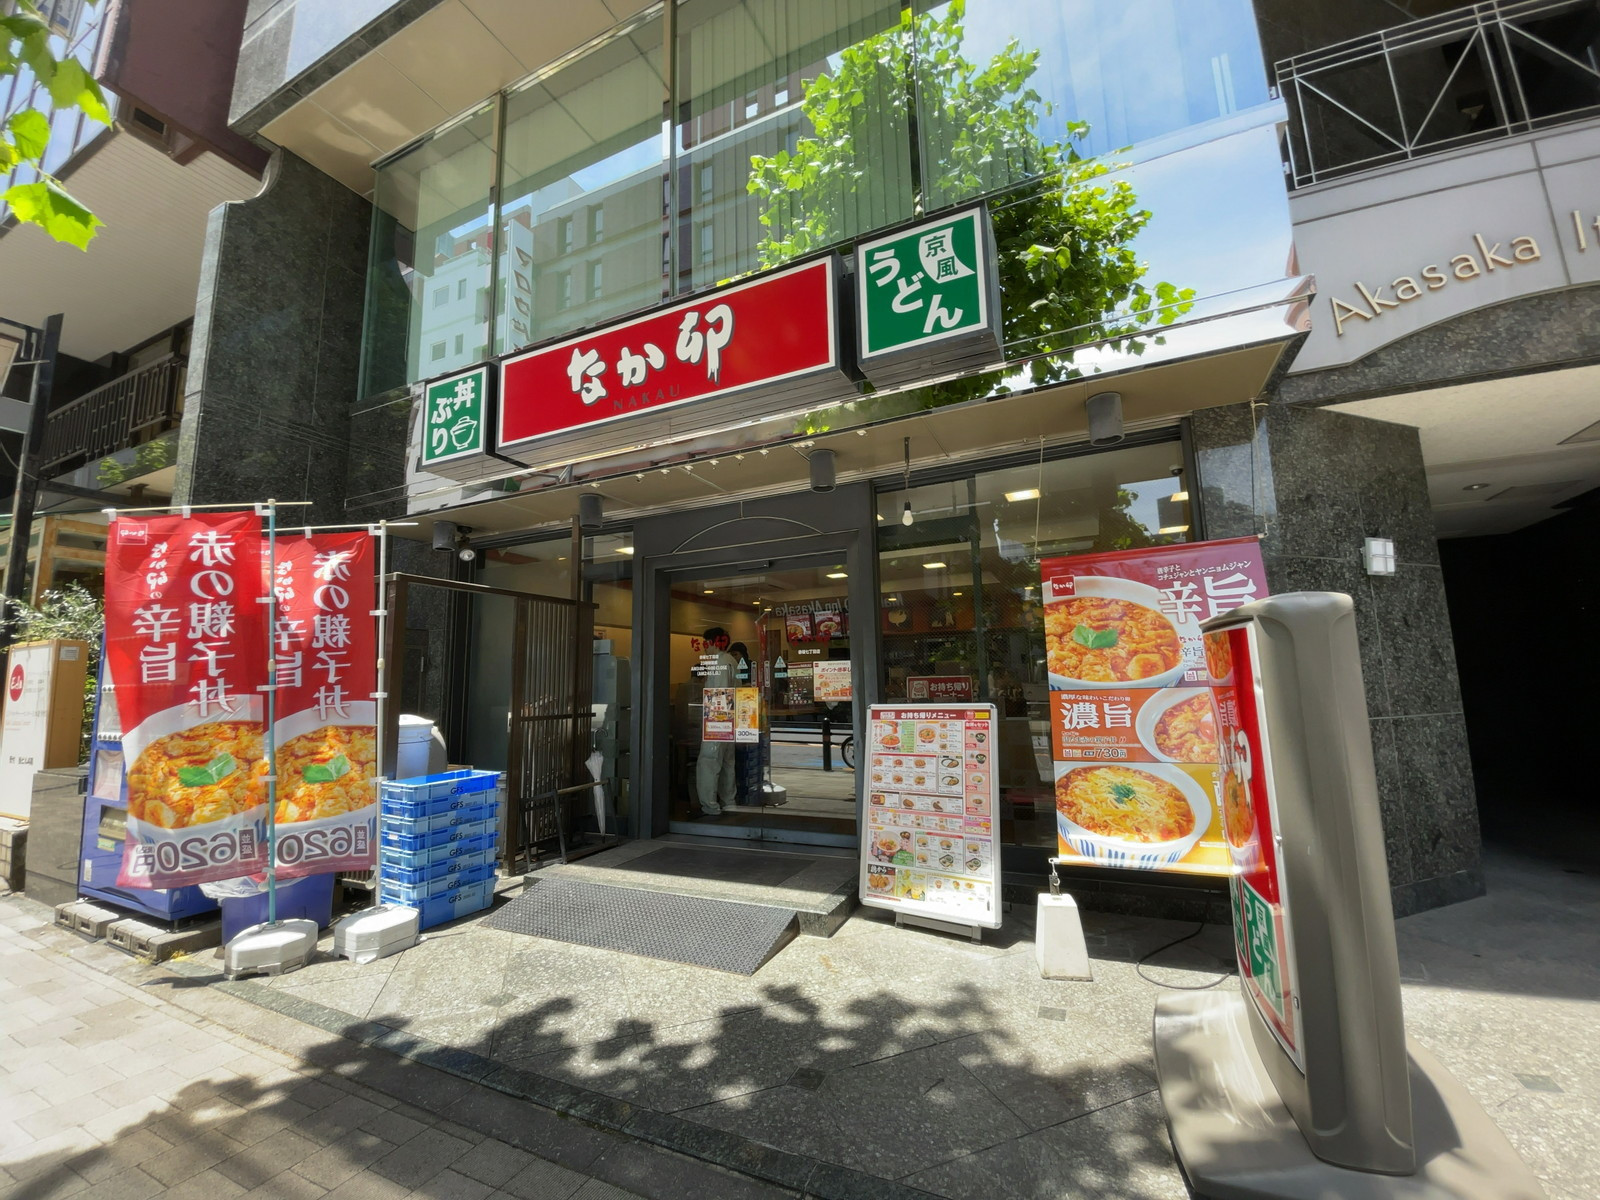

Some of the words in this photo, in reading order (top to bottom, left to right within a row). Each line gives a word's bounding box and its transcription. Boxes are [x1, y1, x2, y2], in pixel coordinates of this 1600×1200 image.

[925, 234, 958, 280] 京風
[869, 248, 963, 333] うどん
[1331, 233, 1541, 336] Akasaka
[567, 303, 735, 405] なか卯
[612, 383, 681, 411] NAKAU
[1160, 572, 1257, 624] 辛旨
[930, 682, 969, 692] お持ち帰り
[1060, 702, 1132, 729] 濃旨
[450, 802, 464, 811] GFS
[449, 833, 463, 842] GFS
[449, 848, 463, 857] GFS
[448, 864, 462, 873] GFS
[447, 880, 461, 889] GFS
[448, 894, 462, 904] GFS
